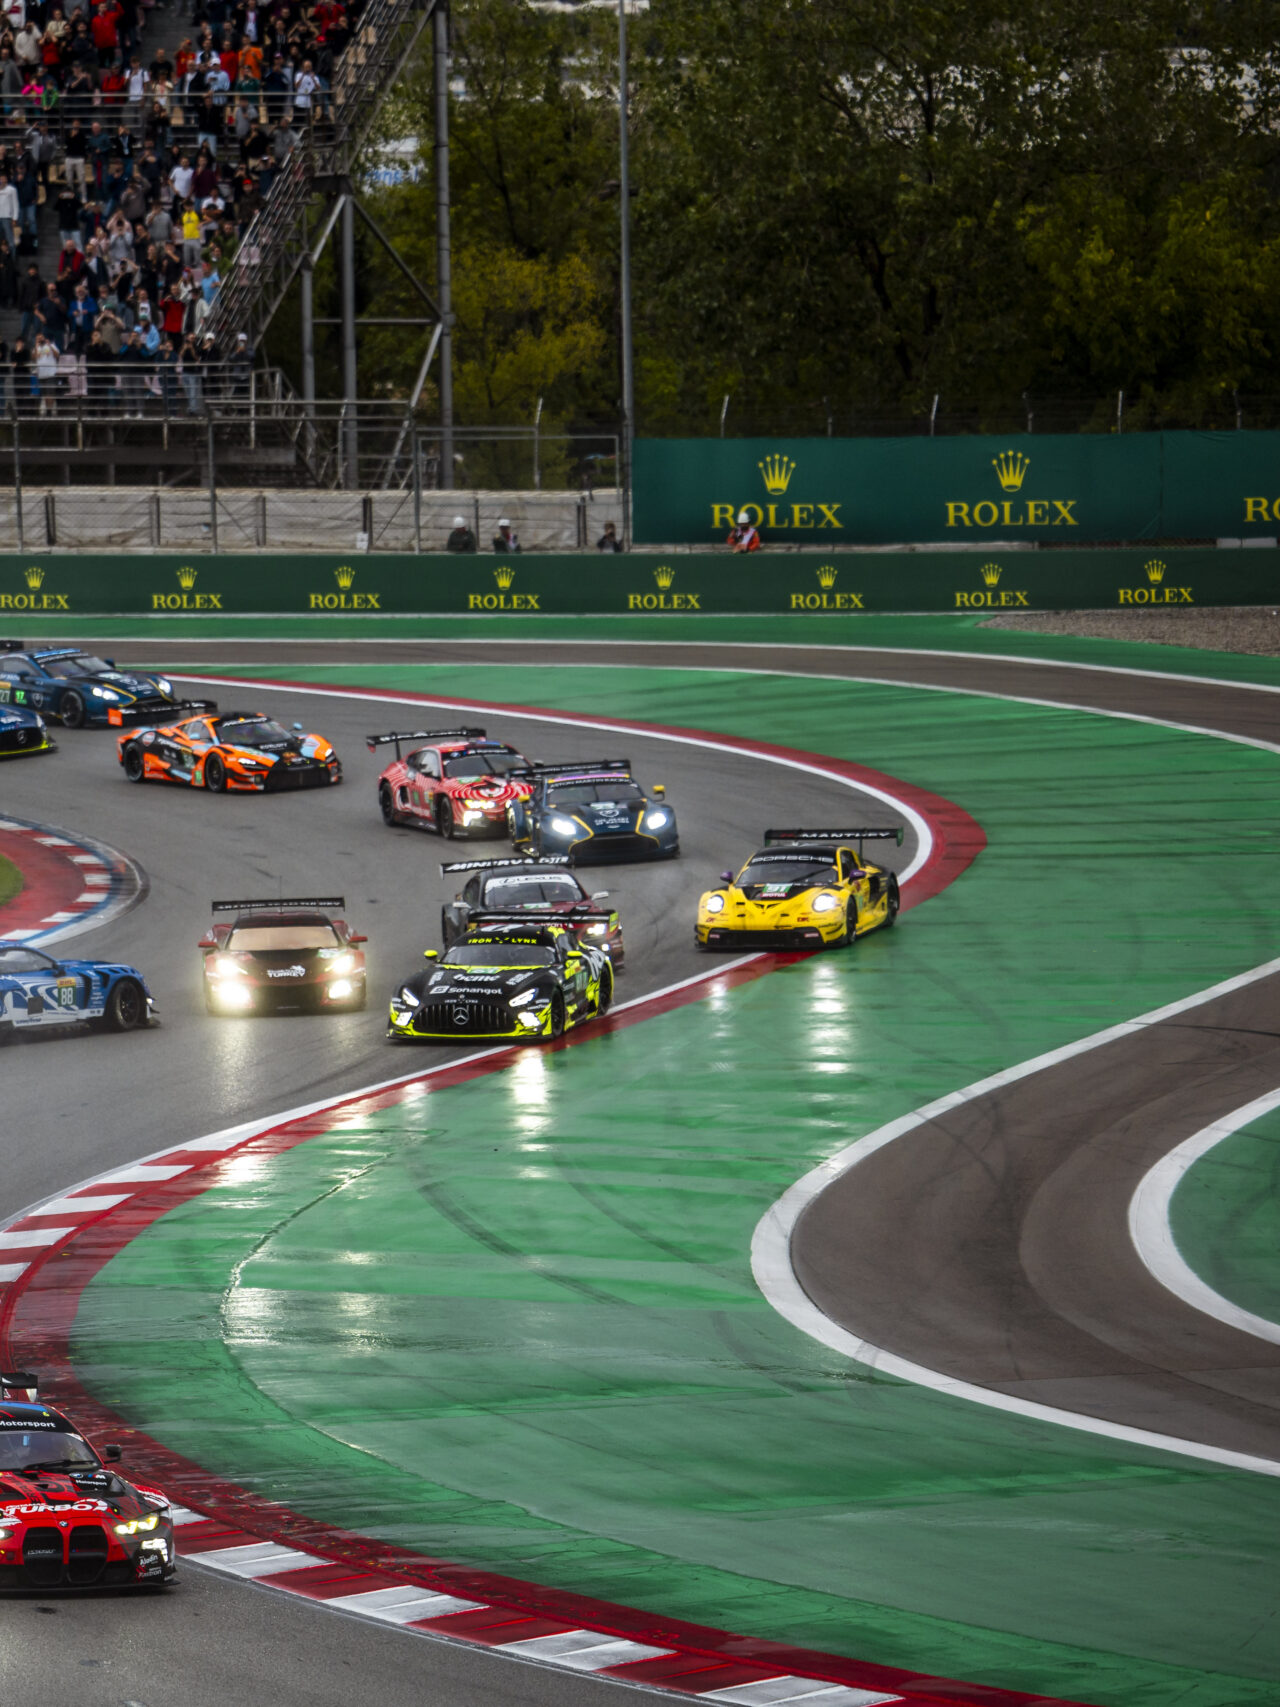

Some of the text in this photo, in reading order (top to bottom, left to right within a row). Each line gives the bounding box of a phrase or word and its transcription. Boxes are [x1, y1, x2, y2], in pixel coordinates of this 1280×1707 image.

[711, 503, 844, 529] ROLEX
[945, 500, 1078, 526] ROLEX
[0, 594, 70, 610] ROLEX
[151, 596, 223, 609] ROLEX
[308, 595, 381, 608] ROLEX
[790, 594, 865, 609] ROLEX
[954, 592, 1030, 608] ROLEX
[1117, 587, 1195, 604] ROLEX
[468, 596, 541, 610] ROLEX
[627, 596, 701, 610] ROLEX
[446, 858, 534, 870] MINERVA
[752, 854, 834, 863] PORSCHE
[765, 884, 787, 893] 91
[267, 968, 306, 978] TURKEY
[61, 987, 74, 1005] 88
[448, 987, 503, 995] Sonangol
[7, 1503, 93, 1516] TURBO
